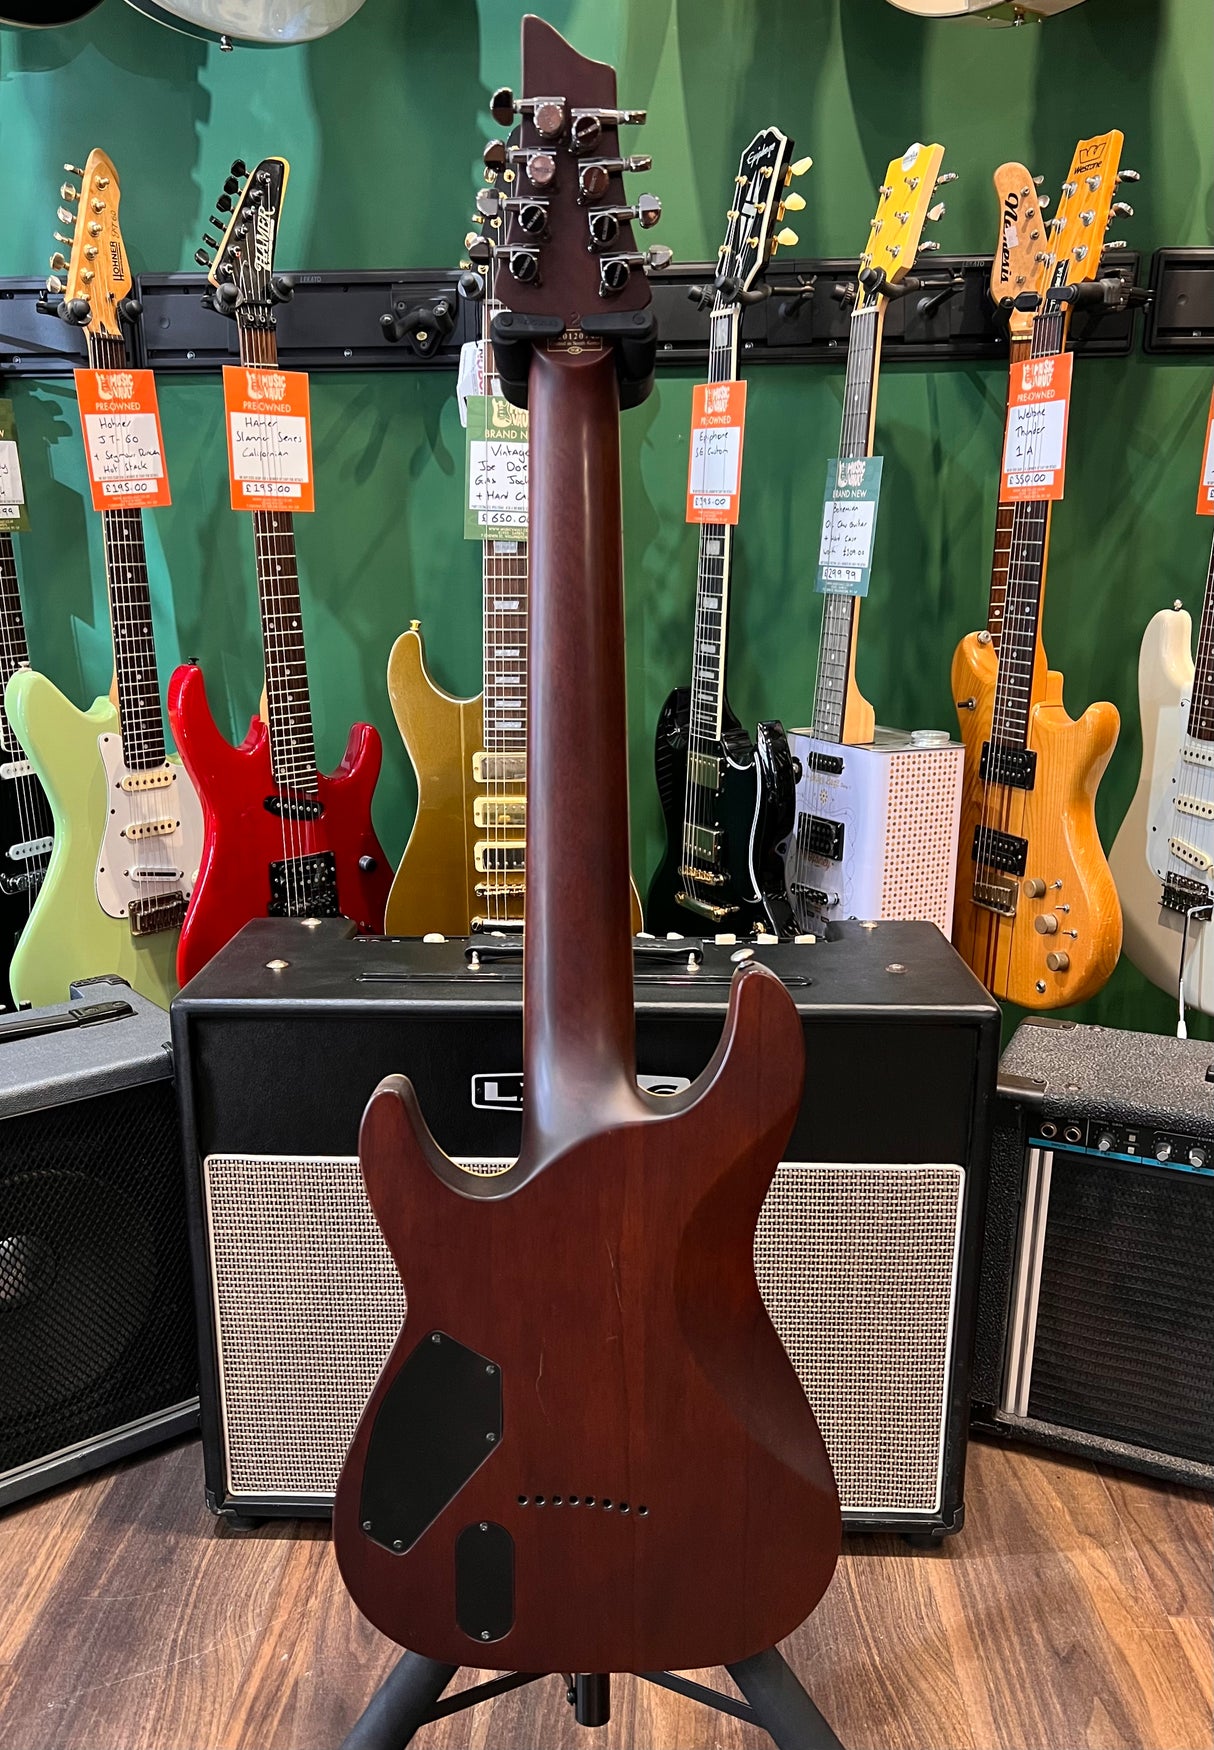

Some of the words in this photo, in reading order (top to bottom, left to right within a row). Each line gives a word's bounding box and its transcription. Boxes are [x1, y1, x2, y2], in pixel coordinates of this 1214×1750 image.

[255, 205, 276, 272] HAMER
[1001, 192, 1019, 284] Neesis
[110, 240, 125, 282] HOHNER
[110, 372, 134, 387] MUSIC
[260, 373, 287, 388] MUSIC
[263, 387, 287, 401] VAULT
[95, 401, 141, 412] PRE-OWNED
[243, 401, 292, 413] PRE-OWNED
[99, 417, 132, 430] Hohner
[511, 413, 529, 428] VAU
[484, 429, 518, 439] BRAND
[1015, 421, 1046, 437] Thunder
[103, 464, 118, 474] Hot
[477, 460, 496, 472] Joe
[474, 474, 497, 486] Gas
[1009, 473, 1046, 485] £350.00
[105, 483, 148, 493] £195.00
[245, 482, 291, 493] £195.00
[851, 488, 868, 498] NEW
[475, 492, 483, 501] +
[515, 491, 527, 501] Ca
